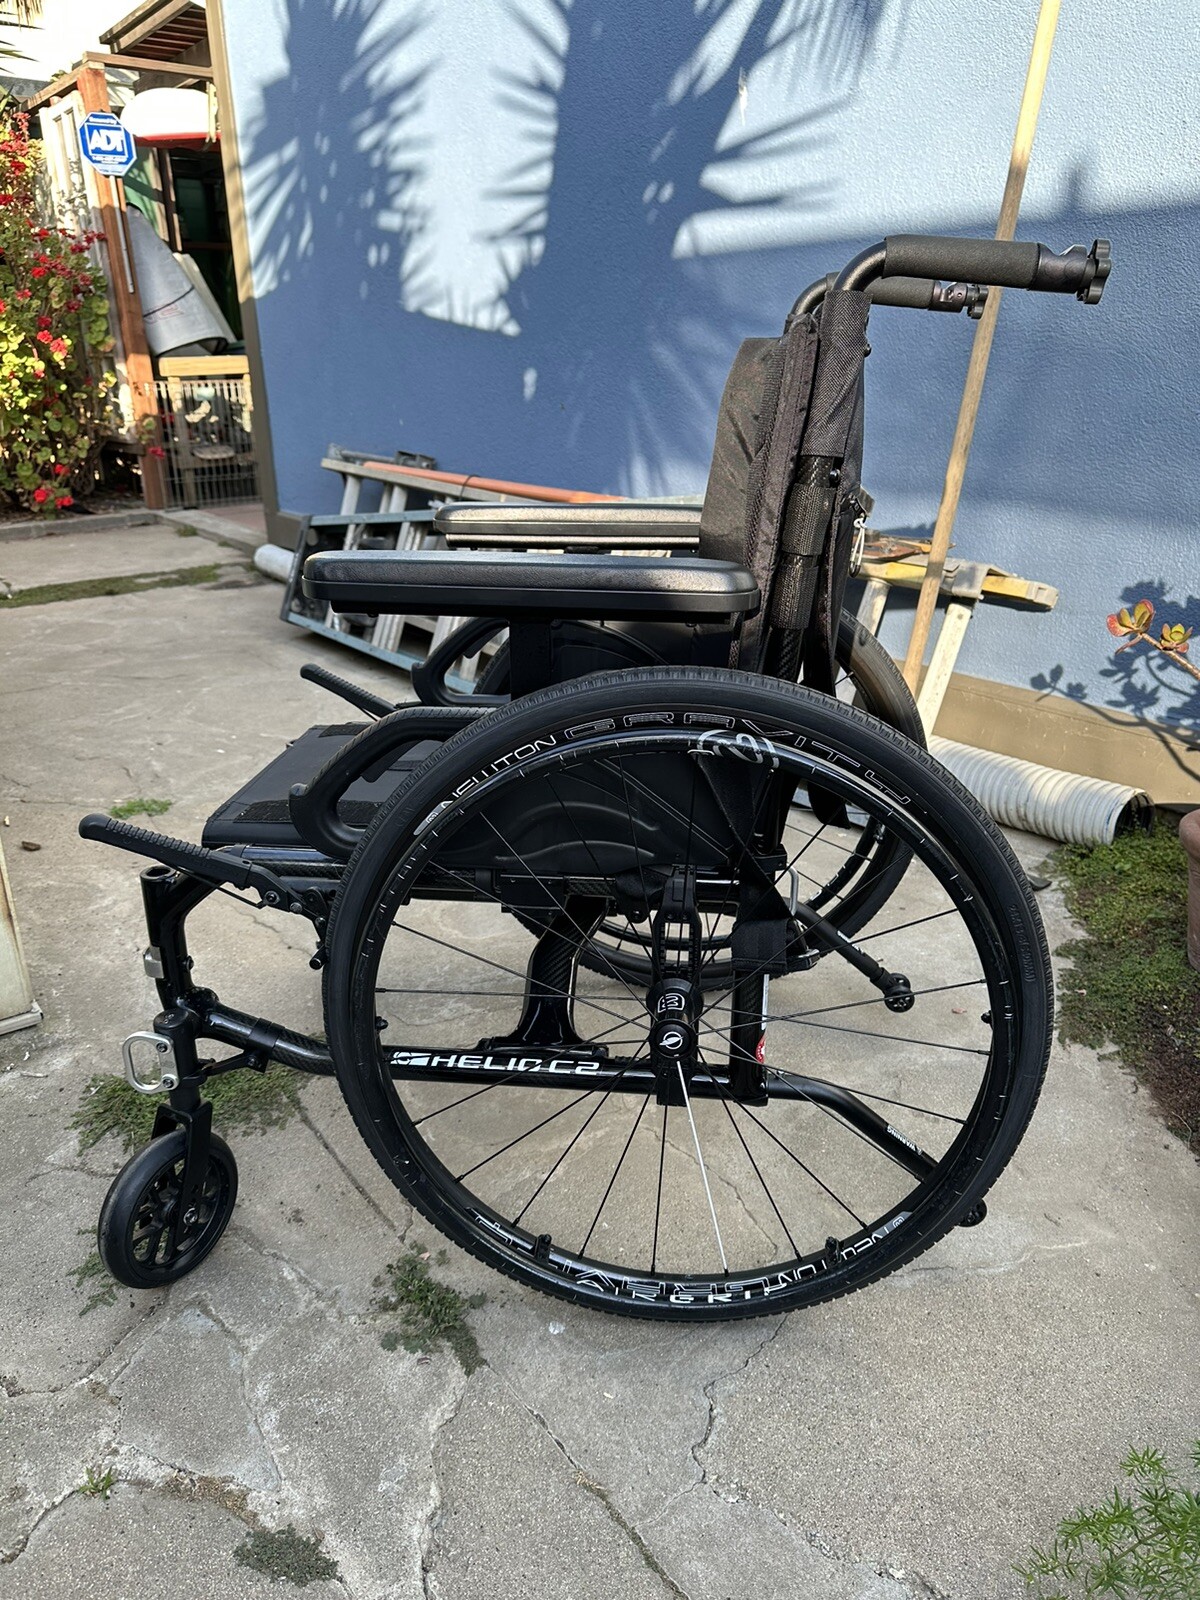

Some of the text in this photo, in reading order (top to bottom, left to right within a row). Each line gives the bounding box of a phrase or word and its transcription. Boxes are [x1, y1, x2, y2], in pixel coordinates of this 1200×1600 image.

[90, 129, 124, 152] ADT
[564, 711, 911, 805] GRAVITY
[431, 1055, 600, 1075] HELIO C2
